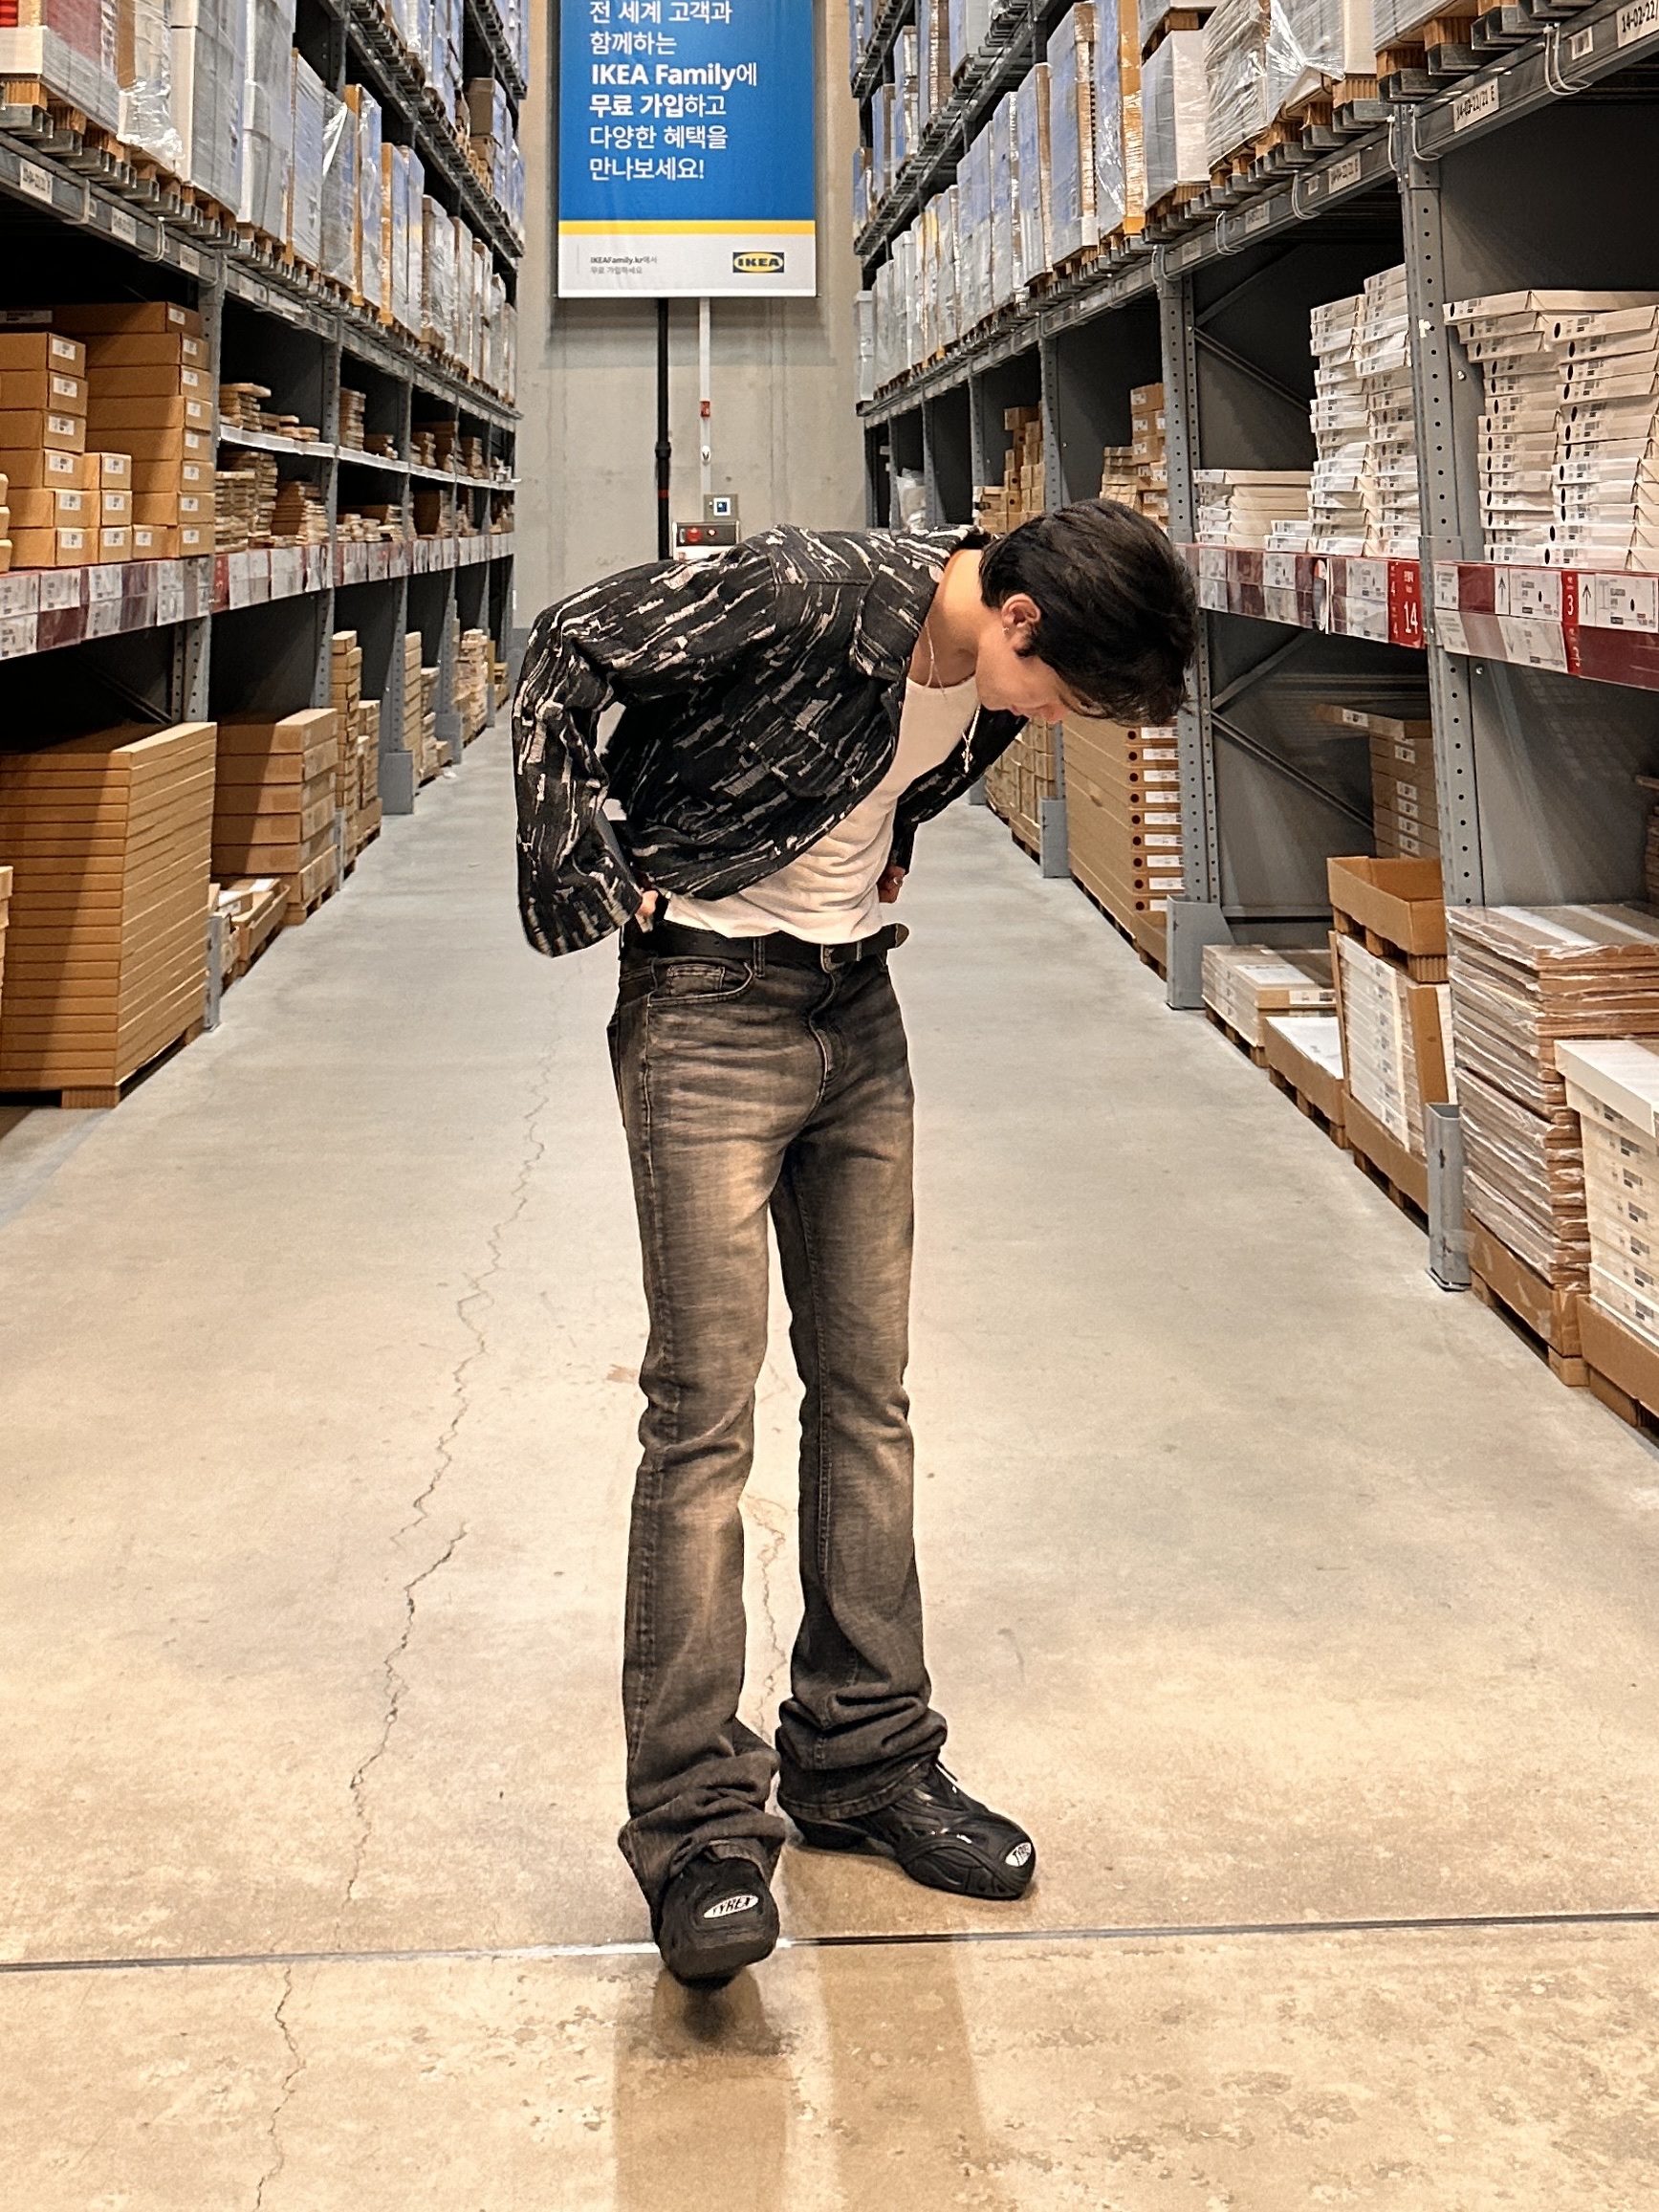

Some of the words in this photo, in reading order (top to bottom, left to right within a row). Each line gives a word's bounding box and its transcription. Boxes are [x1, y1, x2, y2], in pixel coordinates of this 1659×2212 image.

[589, 0, 611, 24] 전
[618, 0, 662, 24] 세계
[668, 0, 733, 24] 고객과
[589, 31, 677, 55] 함께하는
[592, 63, 649, 85] IKEA
[655, 62, 757, 91] Family에
[589, 94, 634, 118] 무료
[640, 93, 727, 118] 가입하고
[589, 125, 657, 149] 다양한
[663, 125, 729, 149] 혜택을
[589, 156, 705, 181] 만나보세요!
[737, 257, 780, 267] IKEA
[1567, 594, 1575, 616] 3
[1403, 601, 1419, 635] 14
